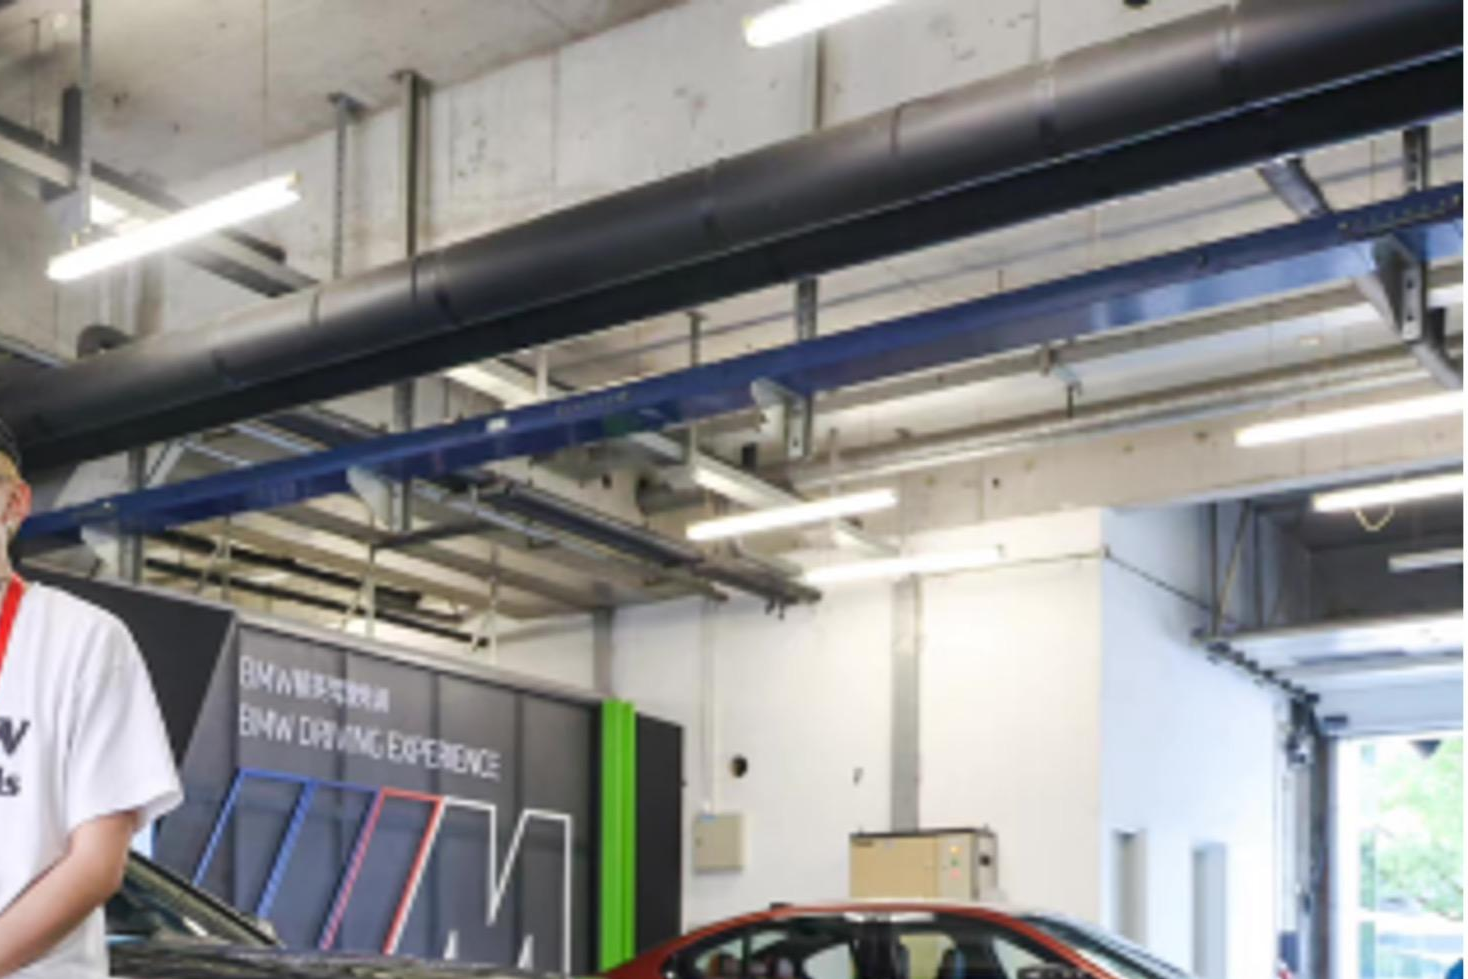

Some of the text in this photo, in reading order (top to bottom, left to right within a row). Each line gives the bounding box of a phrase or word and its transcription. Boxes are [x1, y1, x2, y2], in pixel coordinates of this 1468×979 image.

[238, 702, 501, 781] BMW DRIVING EXPERIENCE
